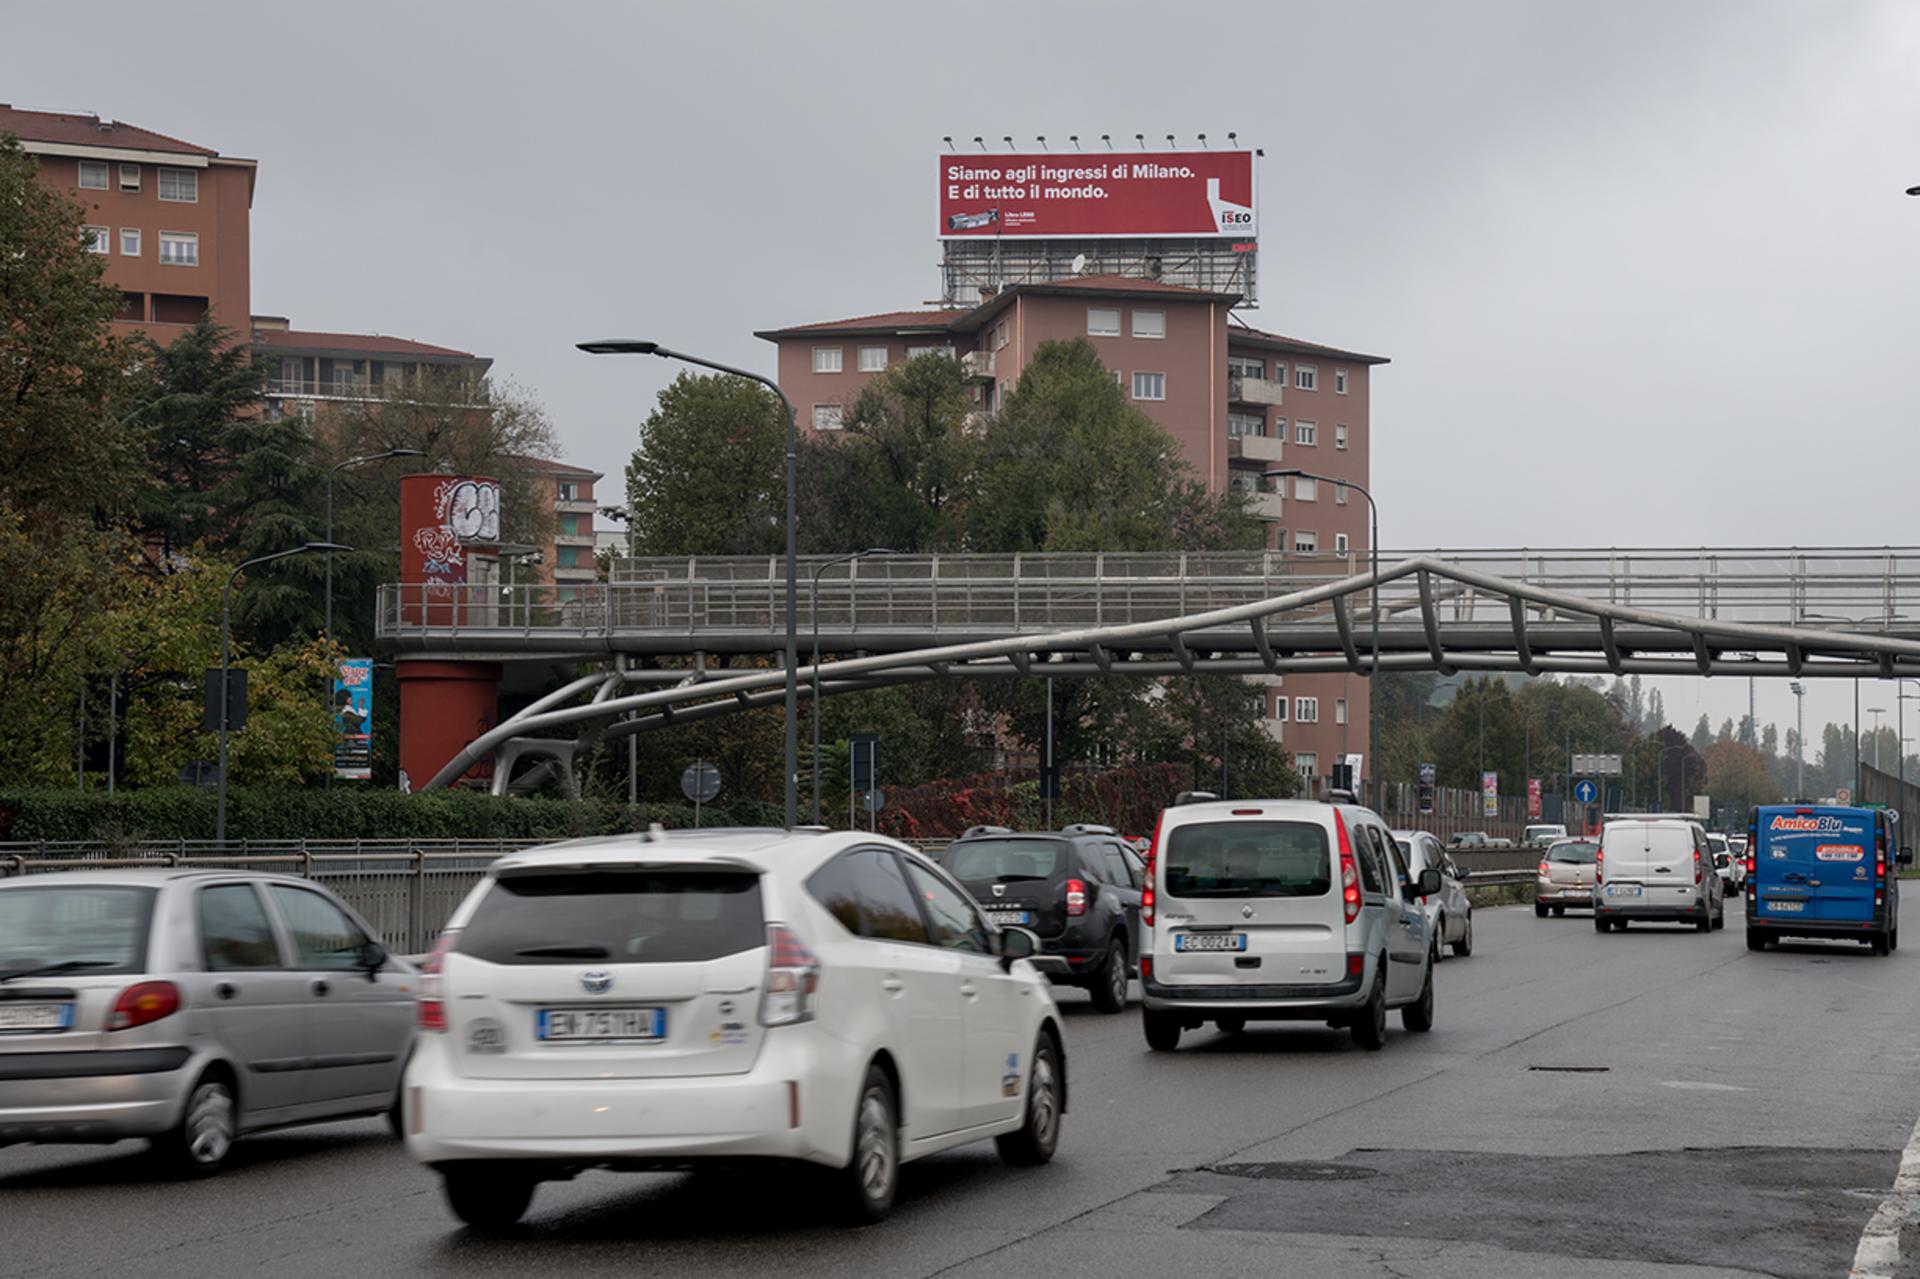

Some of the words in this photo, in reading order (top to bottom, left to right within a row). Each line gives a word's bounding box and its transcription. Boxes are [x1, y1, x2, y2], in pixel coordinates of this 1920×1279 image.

[948, 166, 1001, 181] Siamo
[1005, 165, 1036, 184] agli
[1041, 164, 1107, 184] ingressi
[1112, 164, 1128, 179] di
[1133, 163, 1195, 179] Milano.
[948, 186, 959, 199] E
[964, 185, 979, 199] di
[984, 186, 1025, 199] tutto
[1030, 185, 1040, 199] il
[1045, 185, 1108, 199] mondo.
[1222, 211, 1251, 223] ISEO
[1771, 815, 1842, 831] AmicoBlu
[1183, 936, 1198, 949] EC
